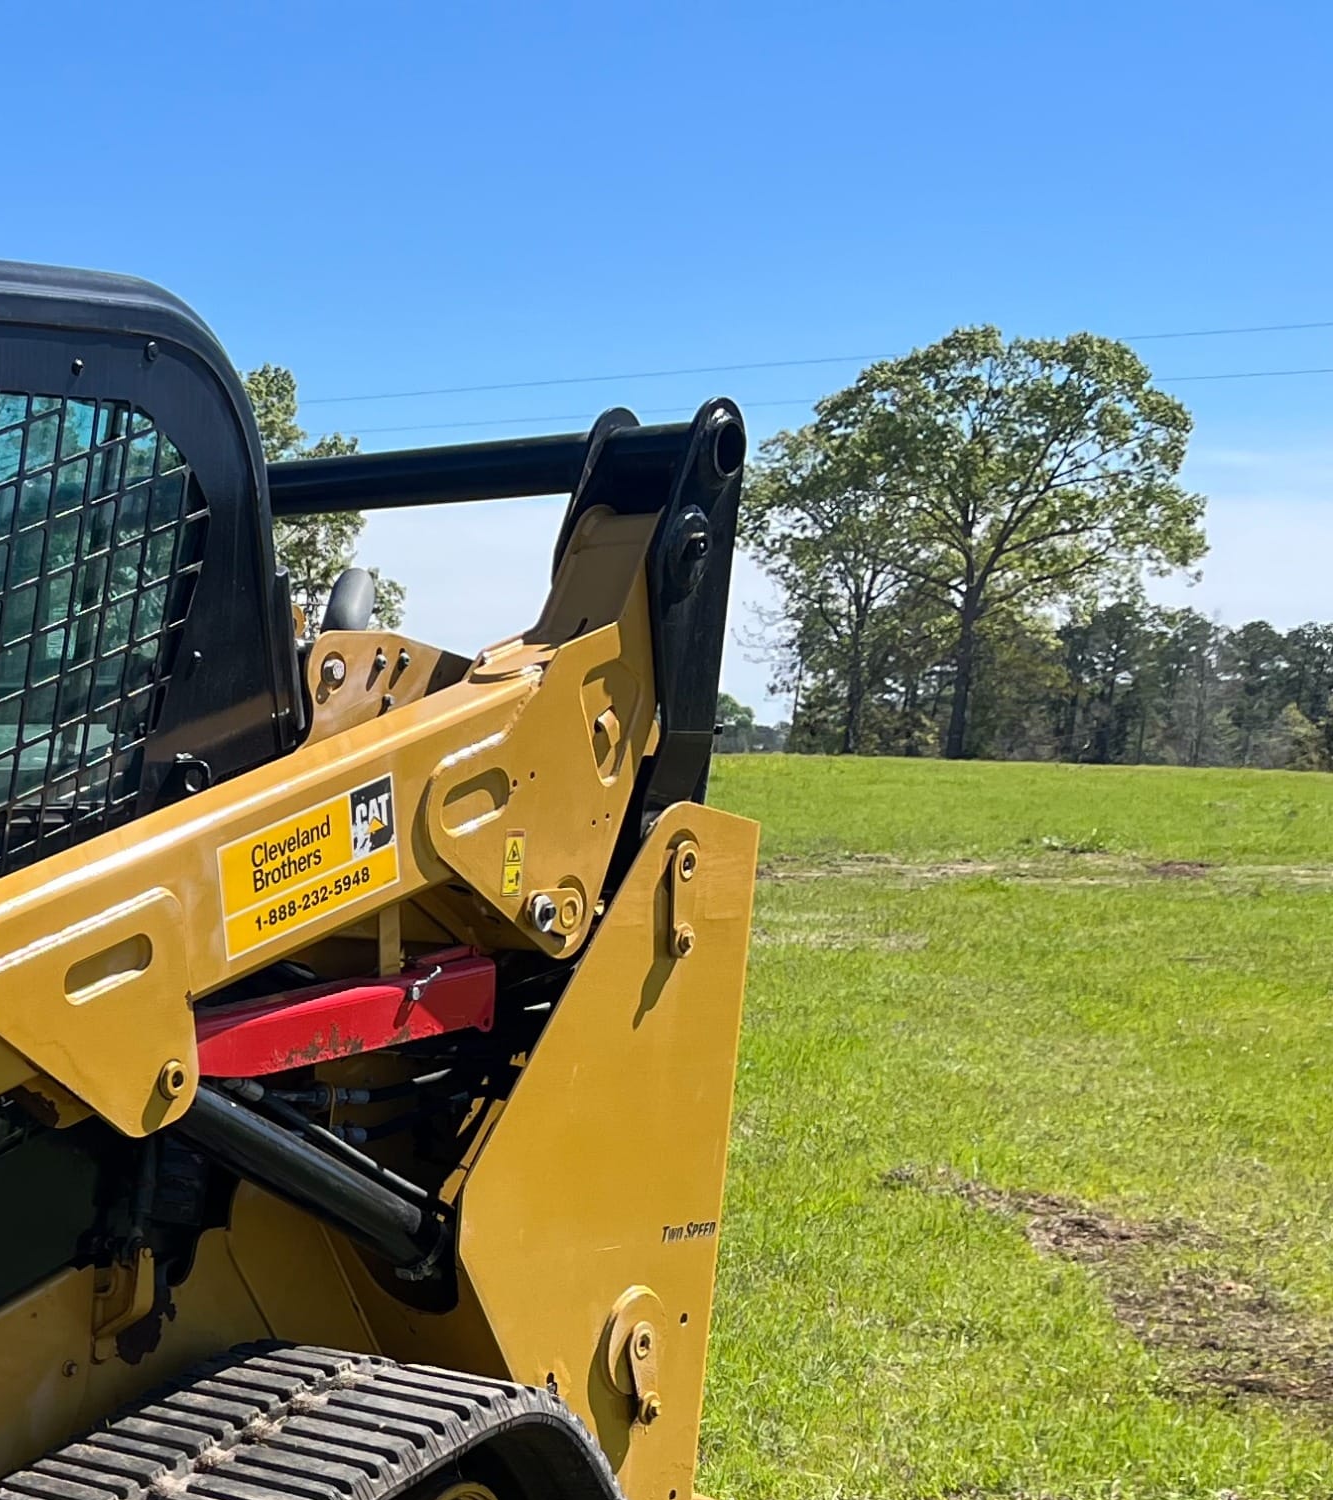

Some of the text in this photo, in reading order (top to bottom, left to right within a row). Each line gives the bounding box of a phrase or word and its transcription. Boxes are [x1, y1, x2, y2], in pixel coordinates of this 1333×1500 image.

[355, 792, 391, 834] CAT
[251, 814, 331, 868] Cleveland
[253, 848, 322, 893] Brothers
[255, 866, 370, 931] 1-888-232-5948
